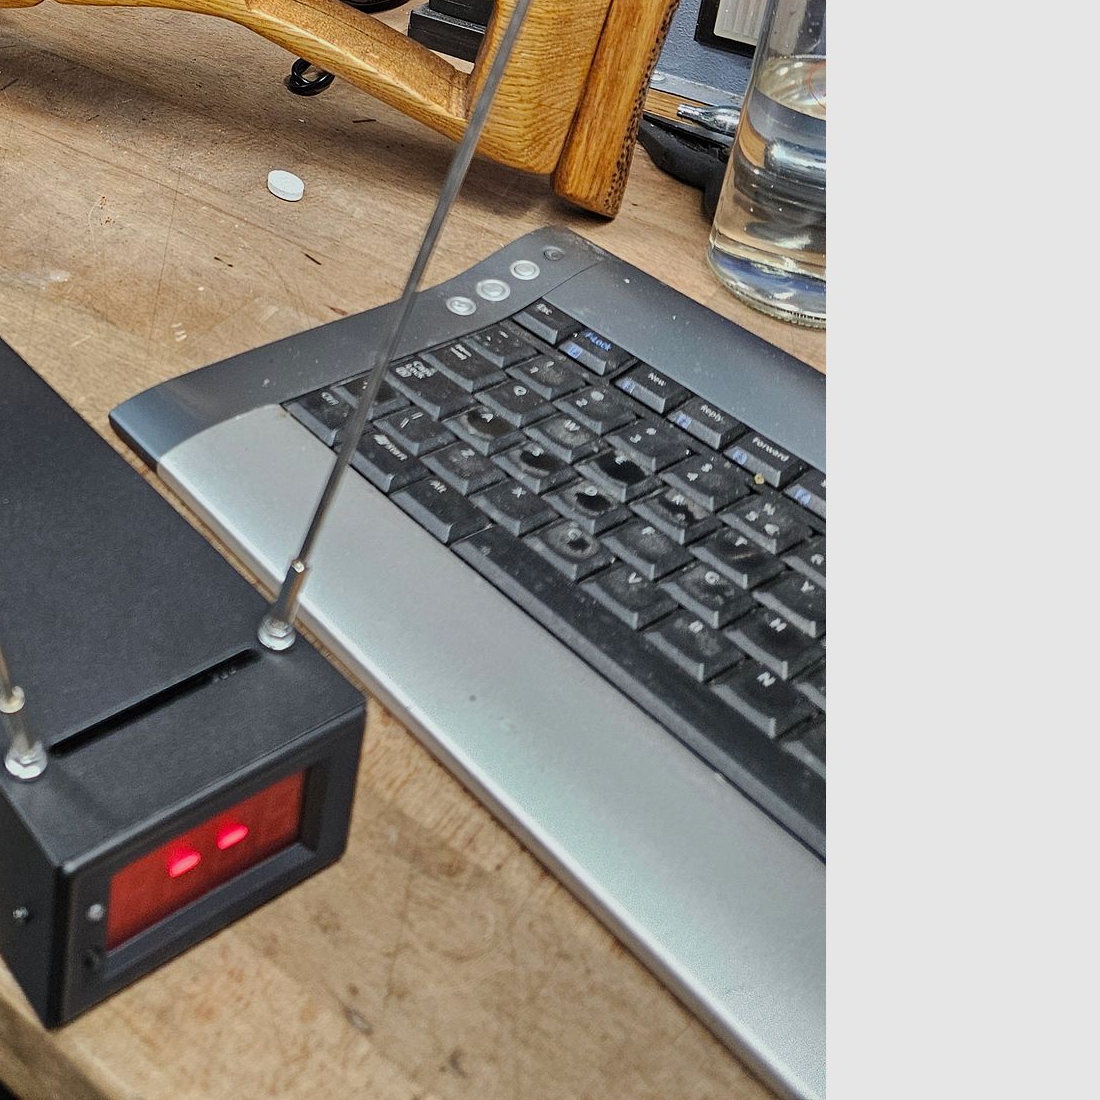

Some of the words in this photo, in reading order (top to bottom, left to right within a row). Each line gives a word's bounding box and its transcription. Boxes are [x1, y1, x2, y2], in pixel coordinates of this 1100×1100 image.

[647, 372, 667, 387] New
[700, 404, 725, 423] Reply
[751, 436, 790, 463] Forward
[429, 479, 447, 495] Alt
